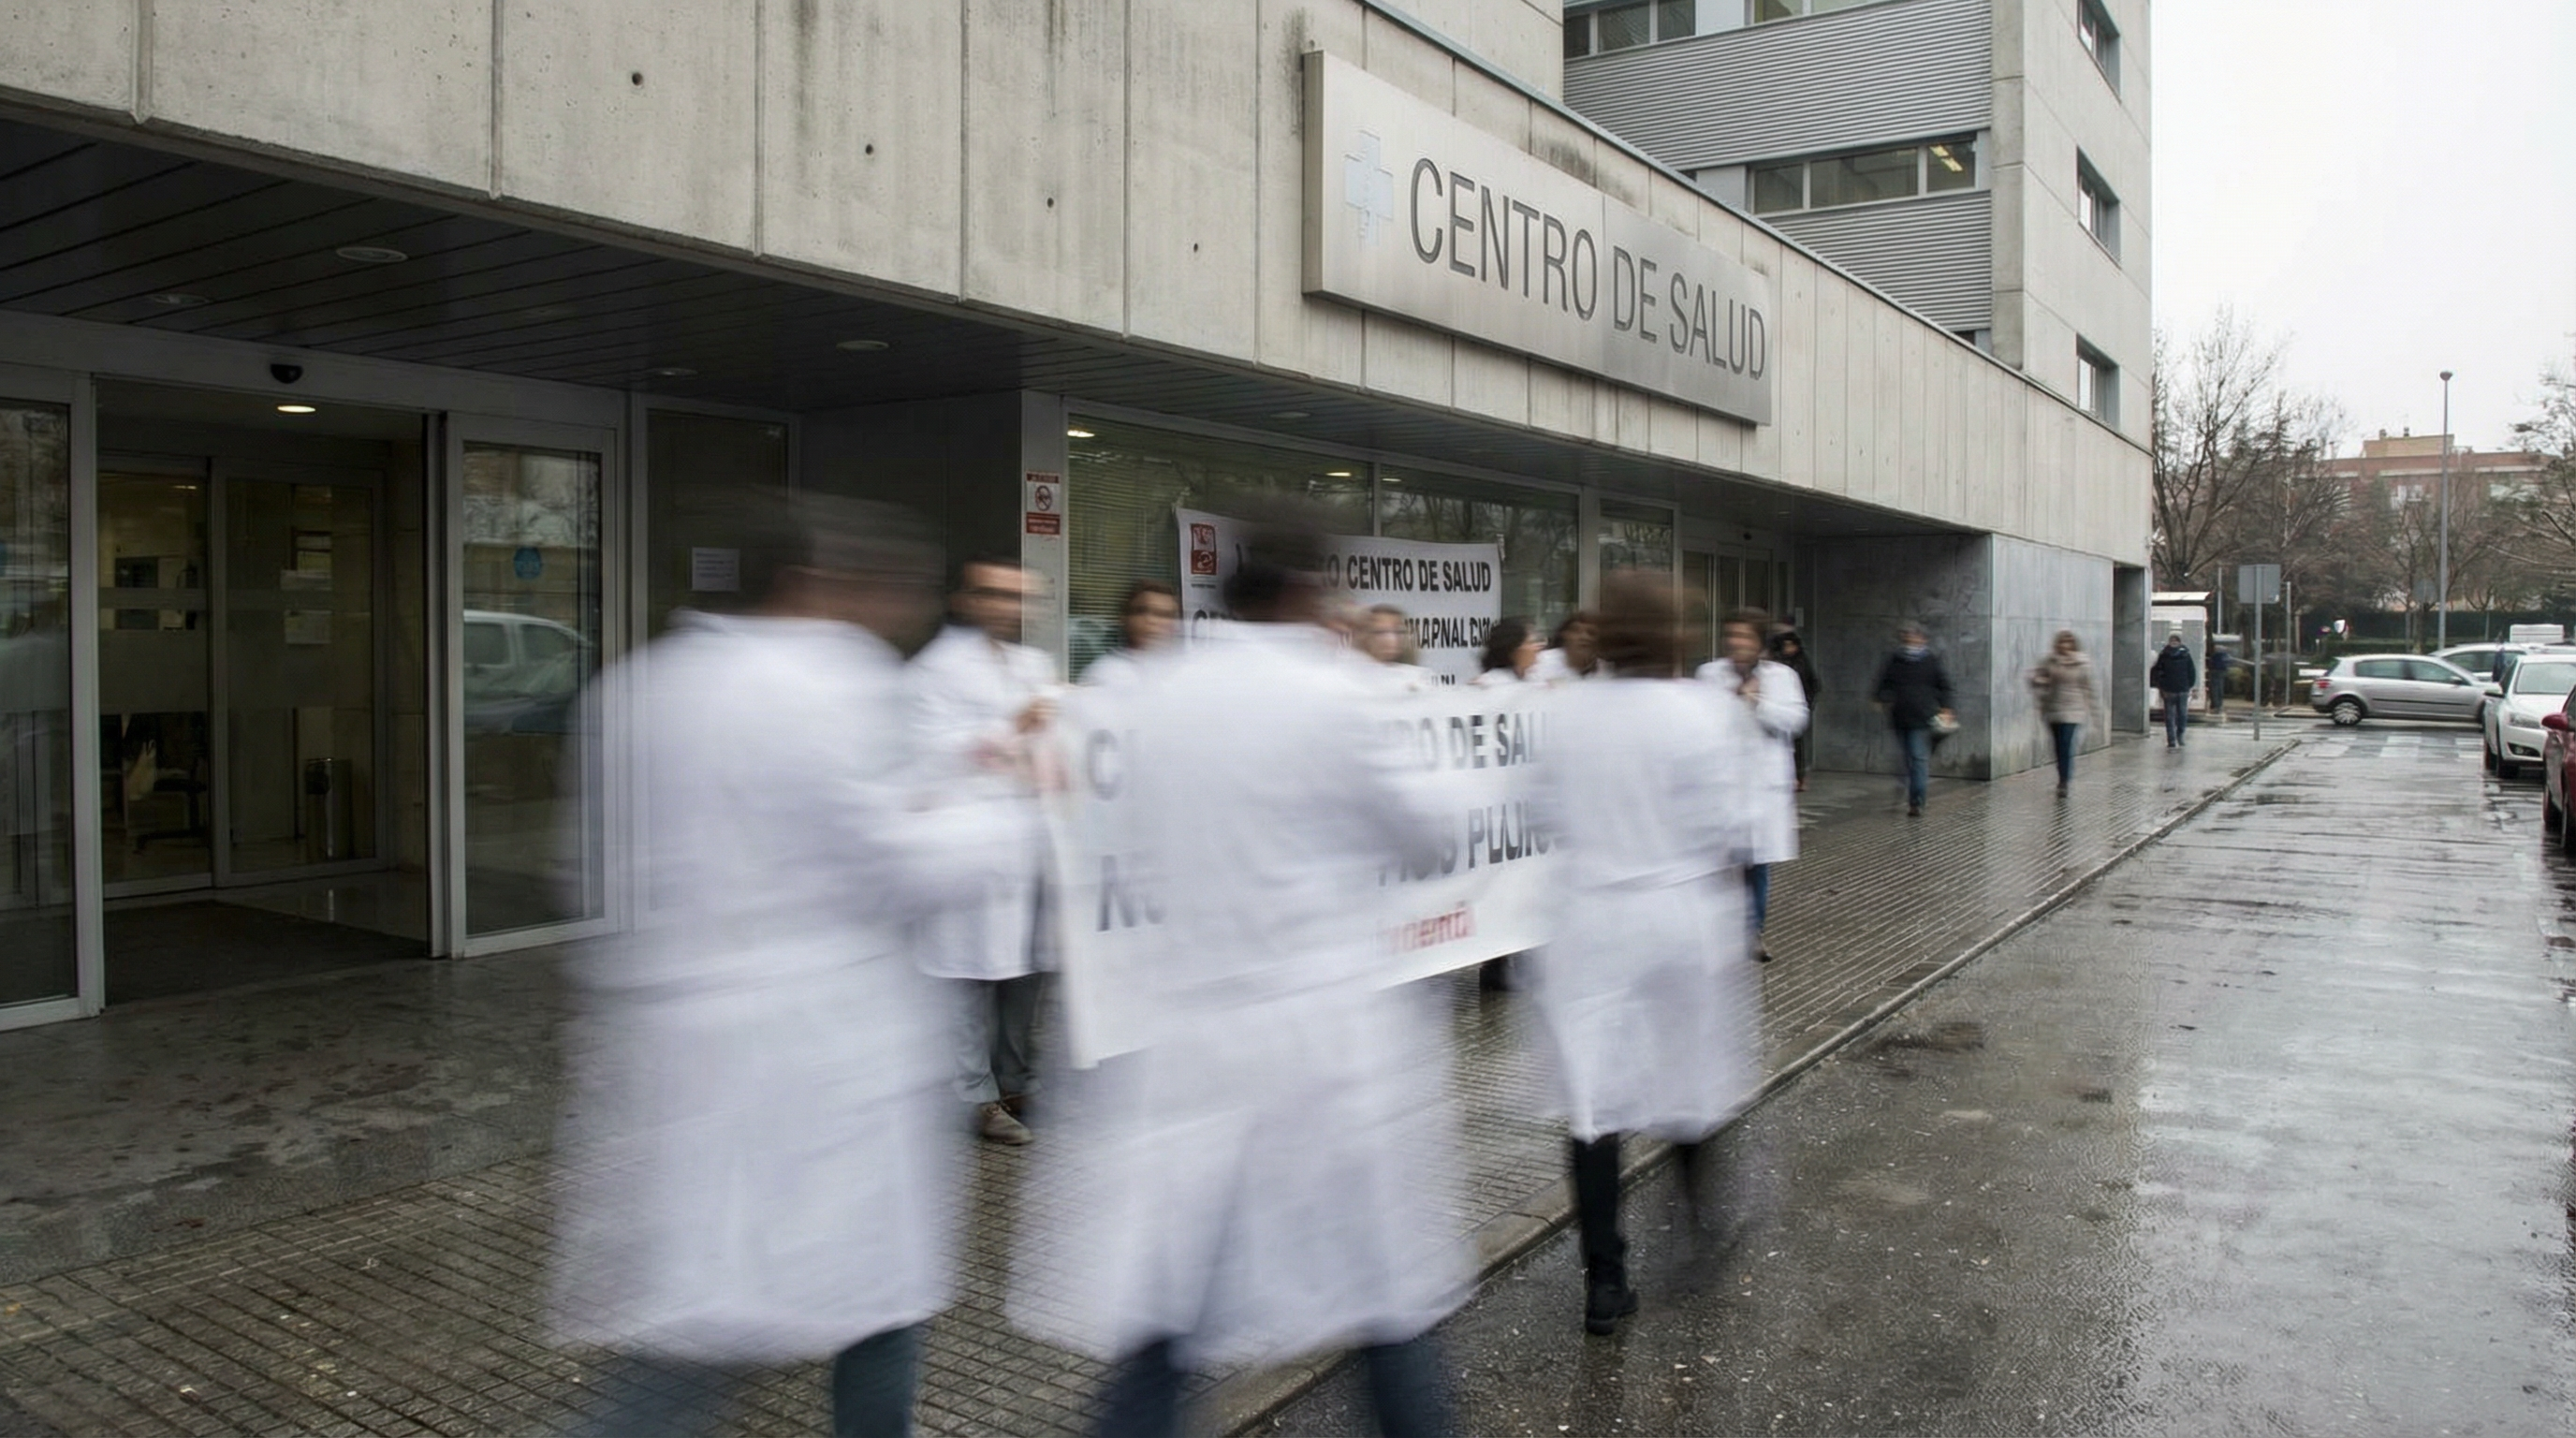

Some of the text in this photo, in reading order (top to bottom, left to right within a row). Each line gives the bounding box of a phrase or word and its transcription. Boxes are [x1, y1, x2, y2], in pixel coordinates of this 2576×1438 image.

[1410, 157, 1765, 381] CENTRO DE SALUD
[1346, 554, 1413, 592] CENTRO
[1418, 560, 1440, 592] DE
[1442, 561, 1492, 593] SALUD
[1447, 714, 1487, 770] DE
